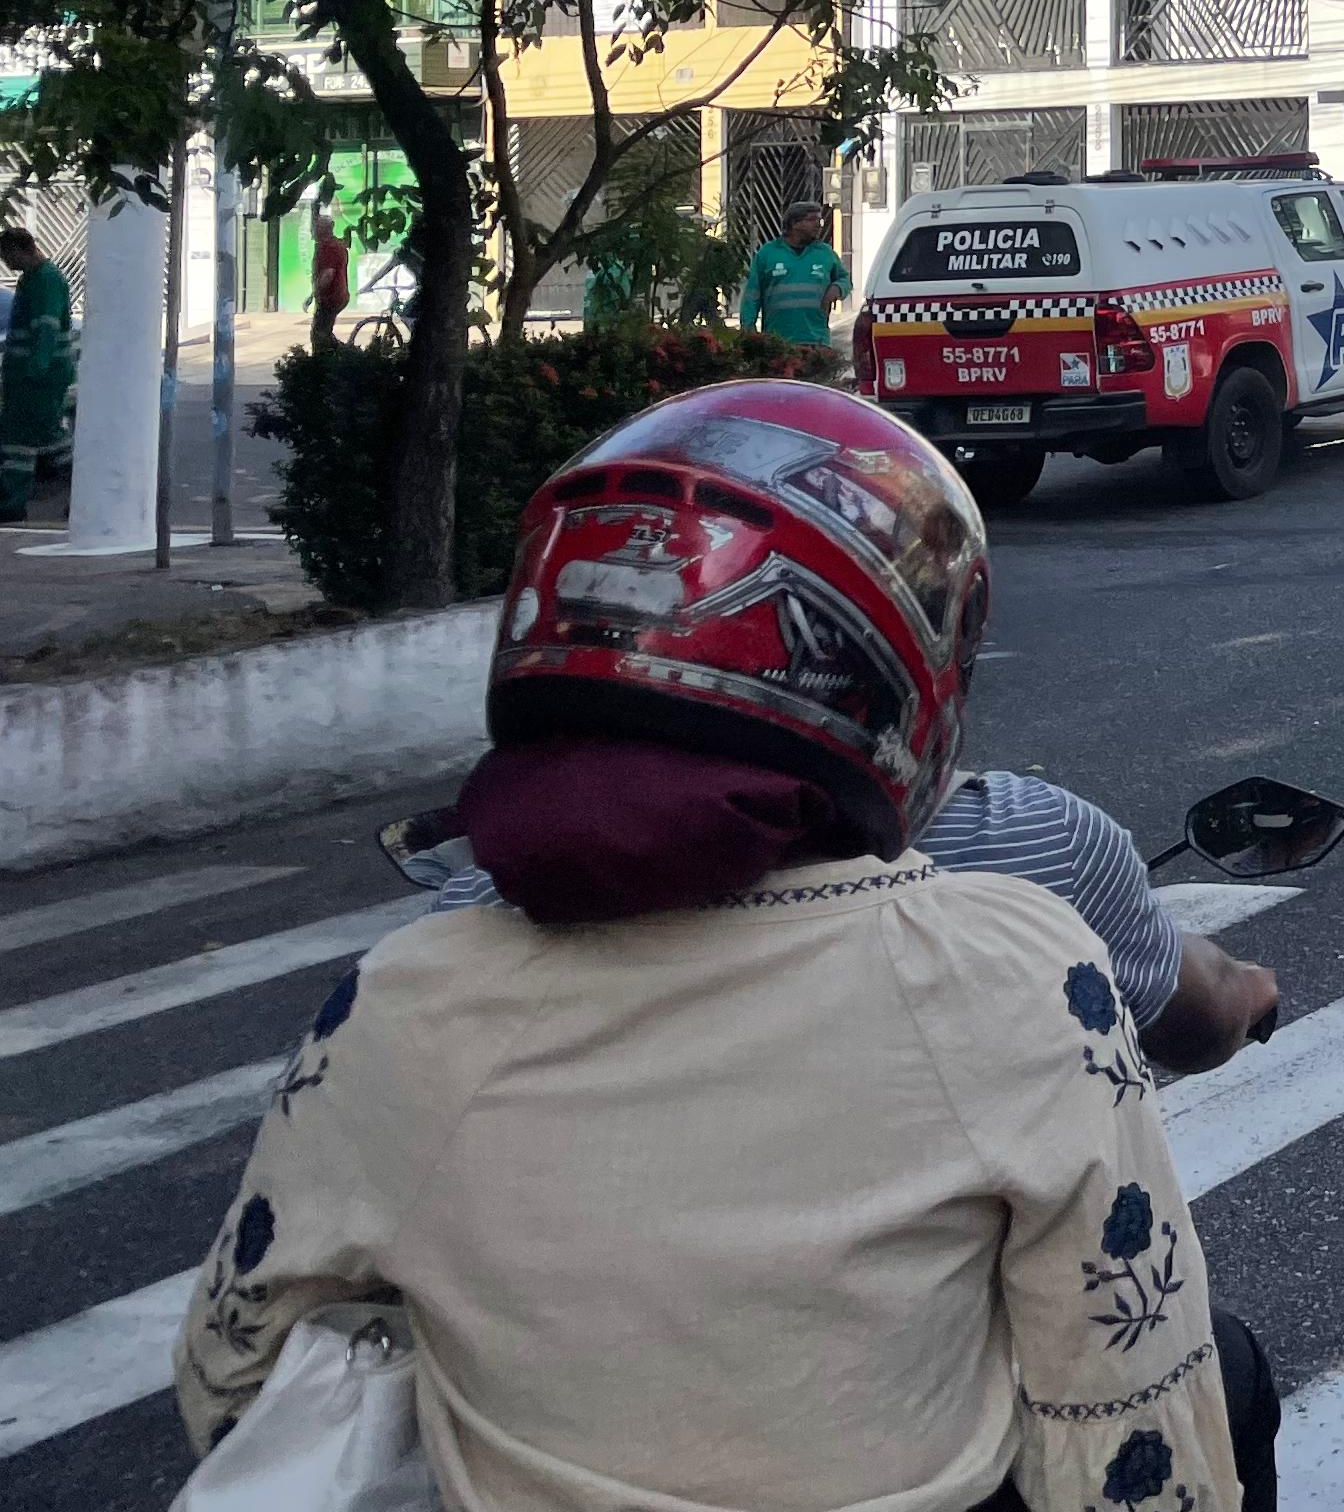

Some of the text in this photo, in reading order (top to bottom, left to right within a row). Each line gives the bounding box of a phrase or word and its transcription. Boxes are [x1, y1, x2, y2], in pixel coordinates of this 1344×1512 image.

[936, 228, 1040, 251] POLICIA
[948, 253, 1071, 271] MILITAR 190
[1251, 308, 1282, 326] BPRV
[1150, 320, 1205, 343] 55-8771
[942, 347, 1020, 363] 55-8771
[957, 368, 1007, 382] BPRV
